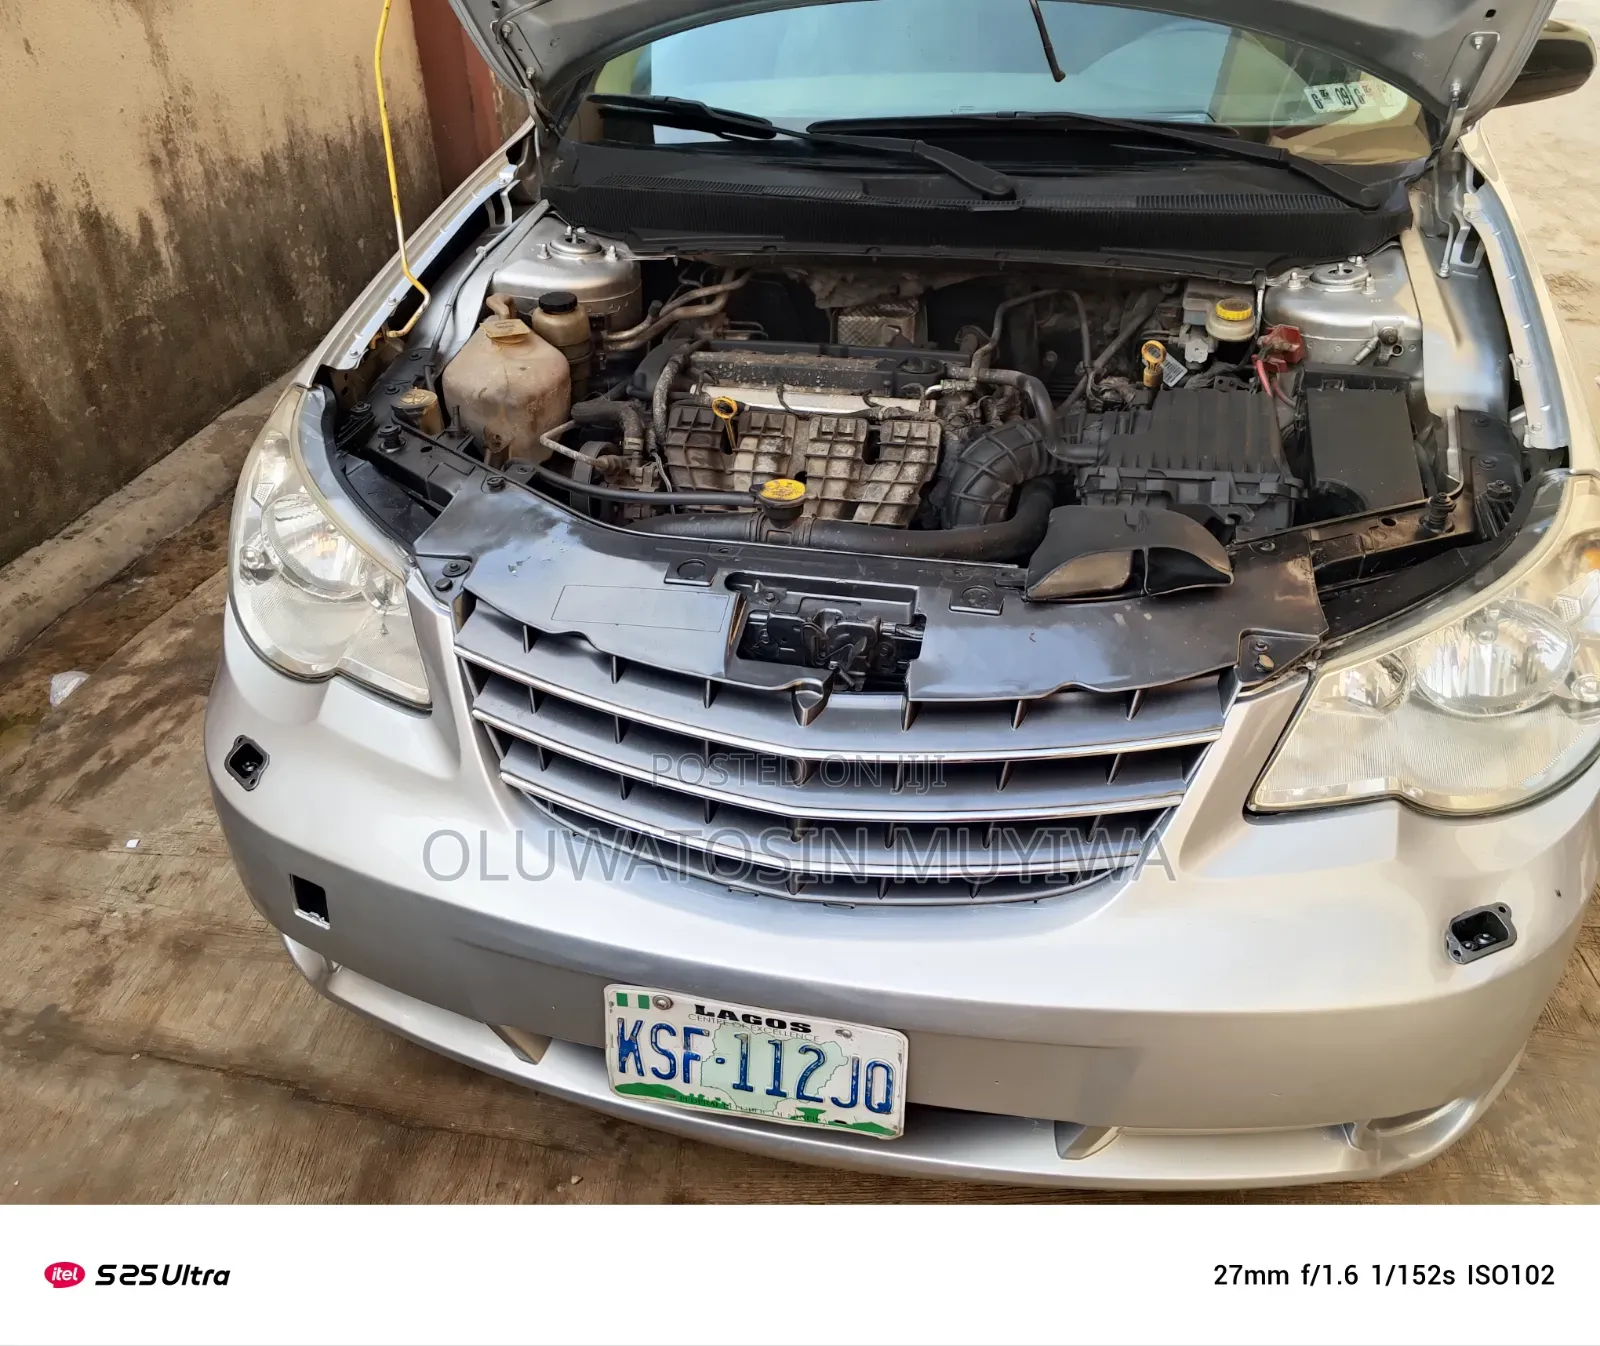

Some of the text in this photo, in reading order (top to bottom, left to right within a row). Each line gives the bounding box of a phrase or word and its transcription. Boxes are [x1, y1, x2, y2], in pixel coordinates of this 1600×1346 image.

[688, 1013, 729, 1026] CENTRE
[750, 1025, 820, 1041] EXCELLENCE
[695, 1004, 811, 1034] LAGOS
